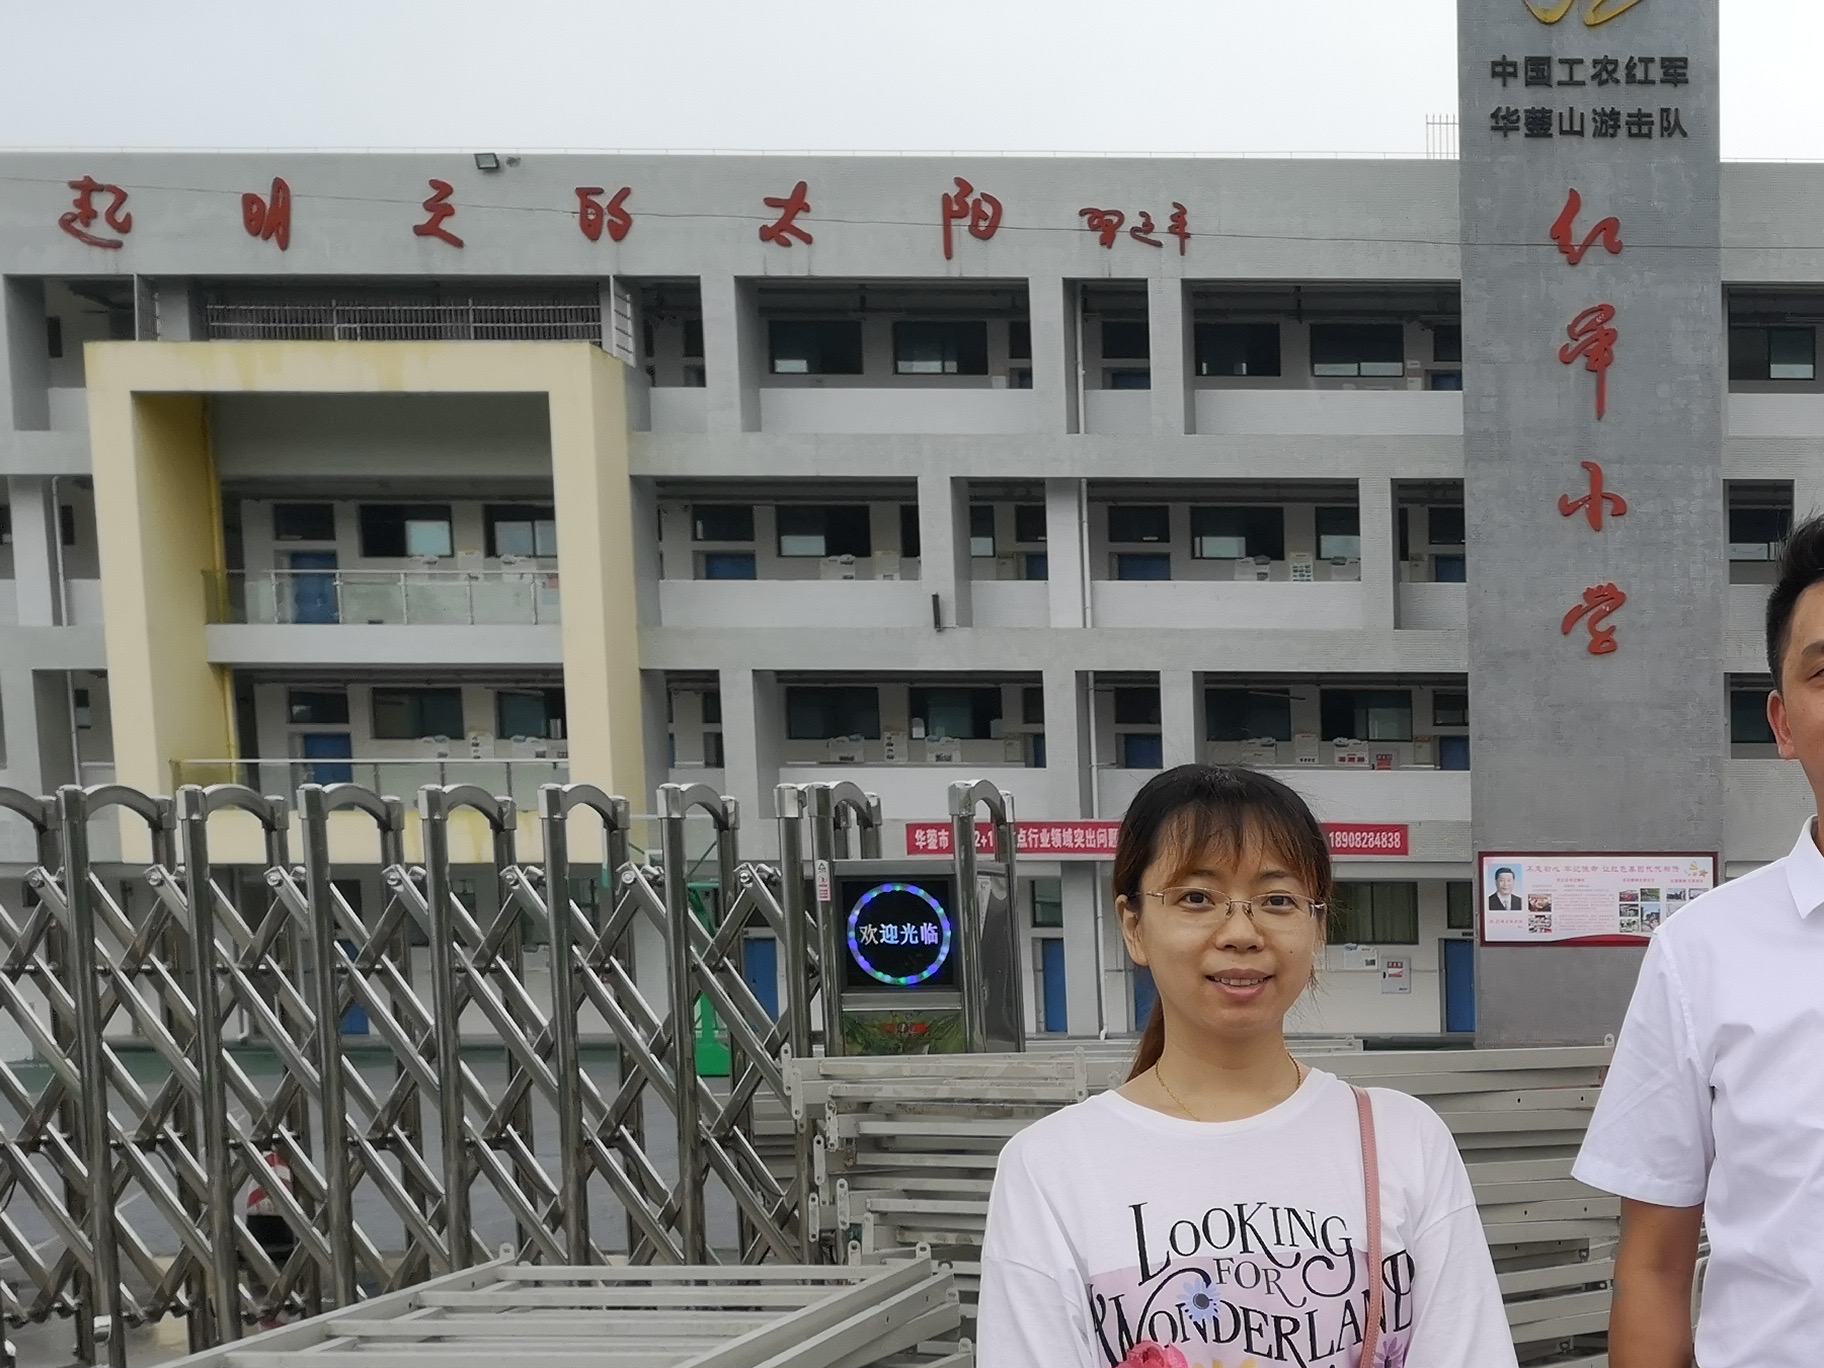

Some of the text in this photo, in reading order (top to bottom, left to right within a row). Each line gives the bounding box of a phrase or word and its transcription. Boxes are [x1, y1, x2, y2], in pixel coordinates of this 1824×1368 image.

[1490, 55, 1690, 88] 中国工农红军
[1490, 106, 1689, 140] 华蓥山游击队
[859, 922, 940, 948] 欢迎光临
[1211, 1257, 1308, 1309] FOR
